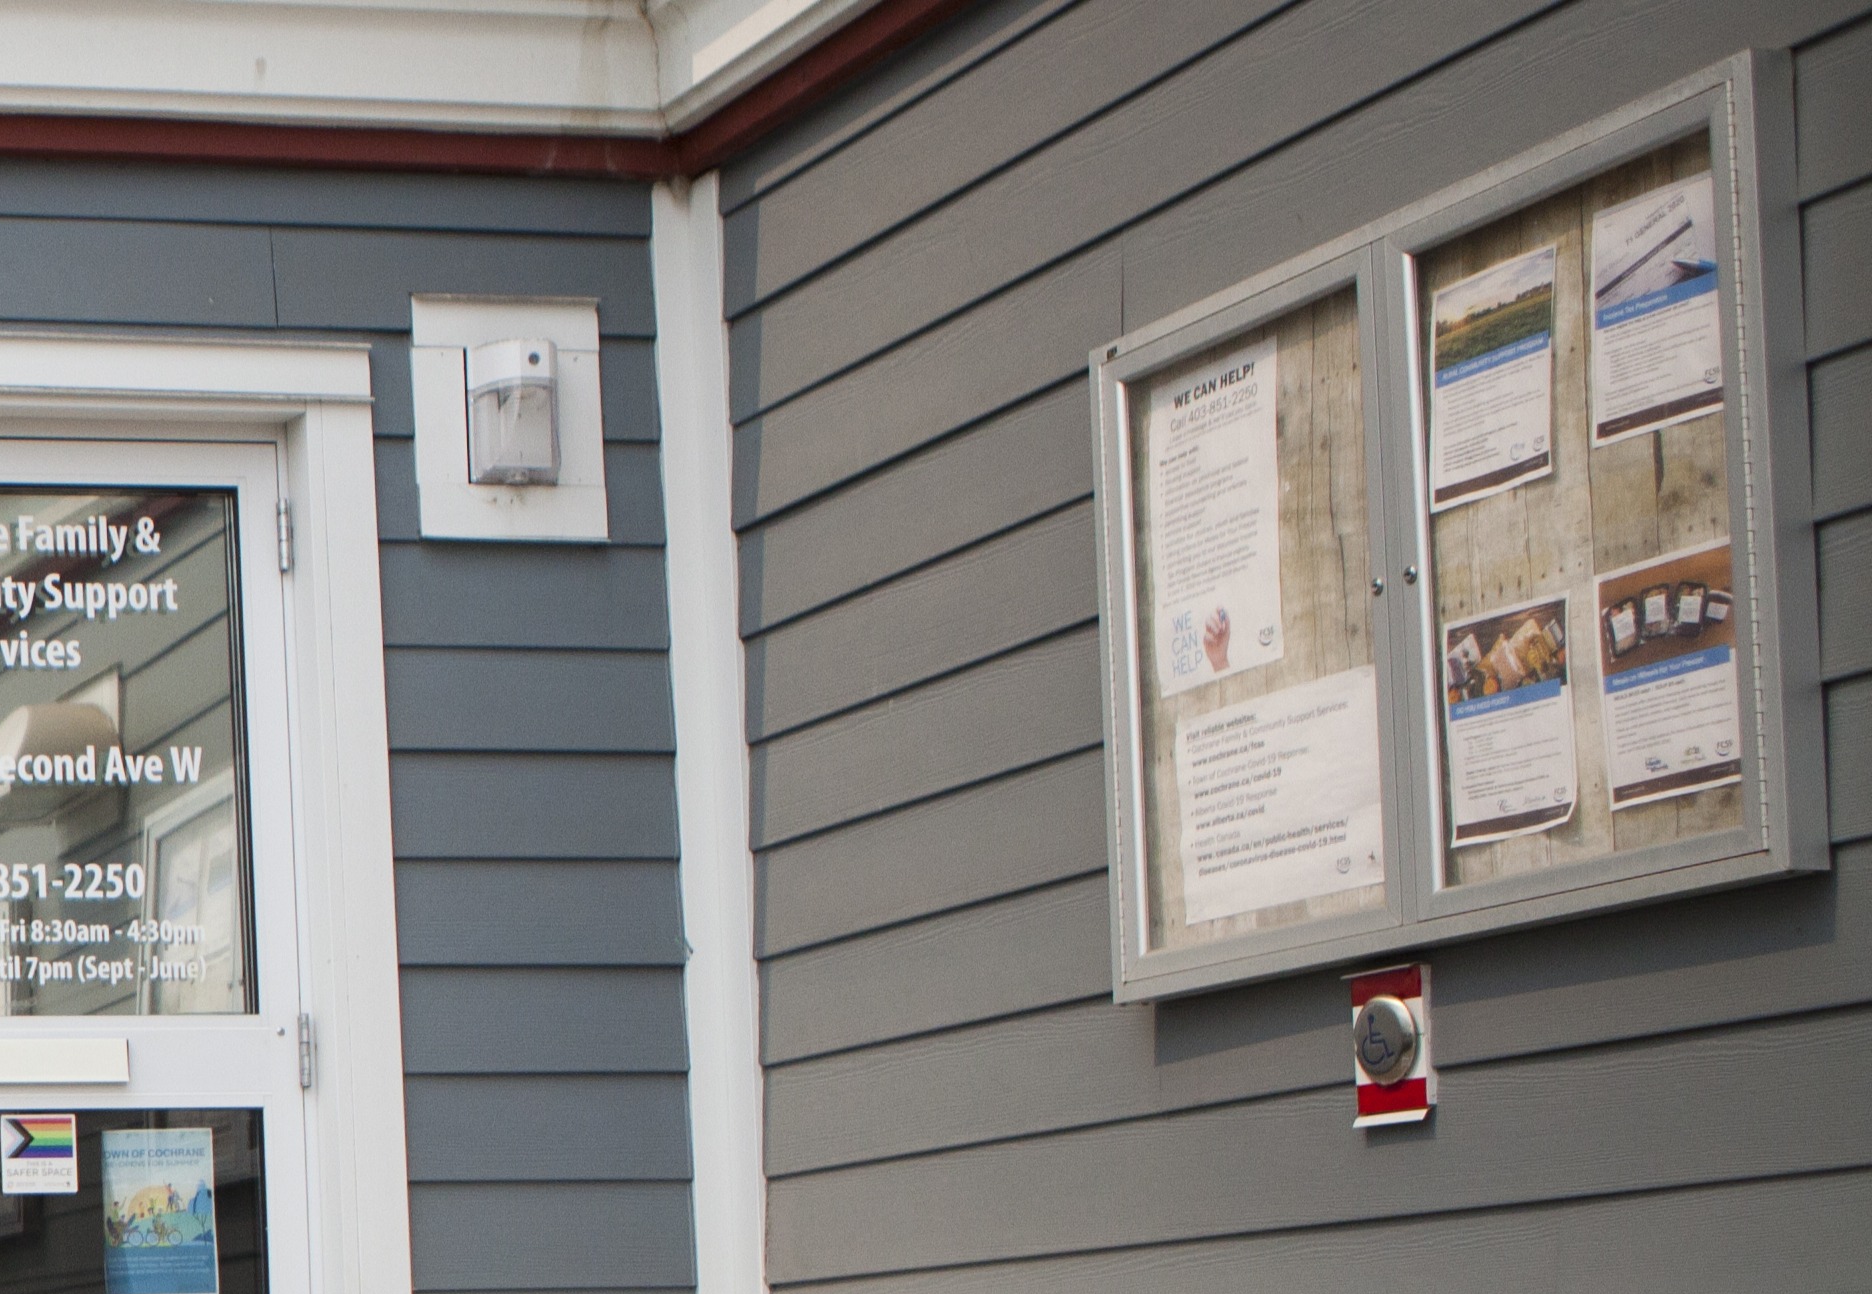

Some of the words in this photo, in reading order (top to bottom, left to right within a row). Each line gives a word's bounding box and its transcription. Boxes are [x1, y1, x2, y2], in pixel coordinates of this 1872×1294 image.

[1173, 388, 1192, 410] WE
[1194, 378, 1217, 401] CAN
[1220, 361, 1255, 389] HELP!
[1188, 382, 1257, 423] 403-851-2250
[19, 516, 128, 562] Family
[136, 517, 161, 553] &
[43, 574, 178, 618] Support
[105, 747, 164, 783] Ave
[171, 746, 202, 782] W
[0, 919, 26, 944] Fri
[31, 919, 110, 944] 8:30am
[127, 919, 205, 951] 4:30pm
[26, 957, 72, 986] 7pm
[78, 955, 133, 987] (Sept
[150, 955, 206, 984] June)
[6, 1168, 39, 1177] SAFER
[41, 1167, 73, 1177] SPACE
[102, 1148, 129, 1160] OWN
[132, 1149, 145, 1159] OF
[148, 1147, 205, 1158] COCHRANE
